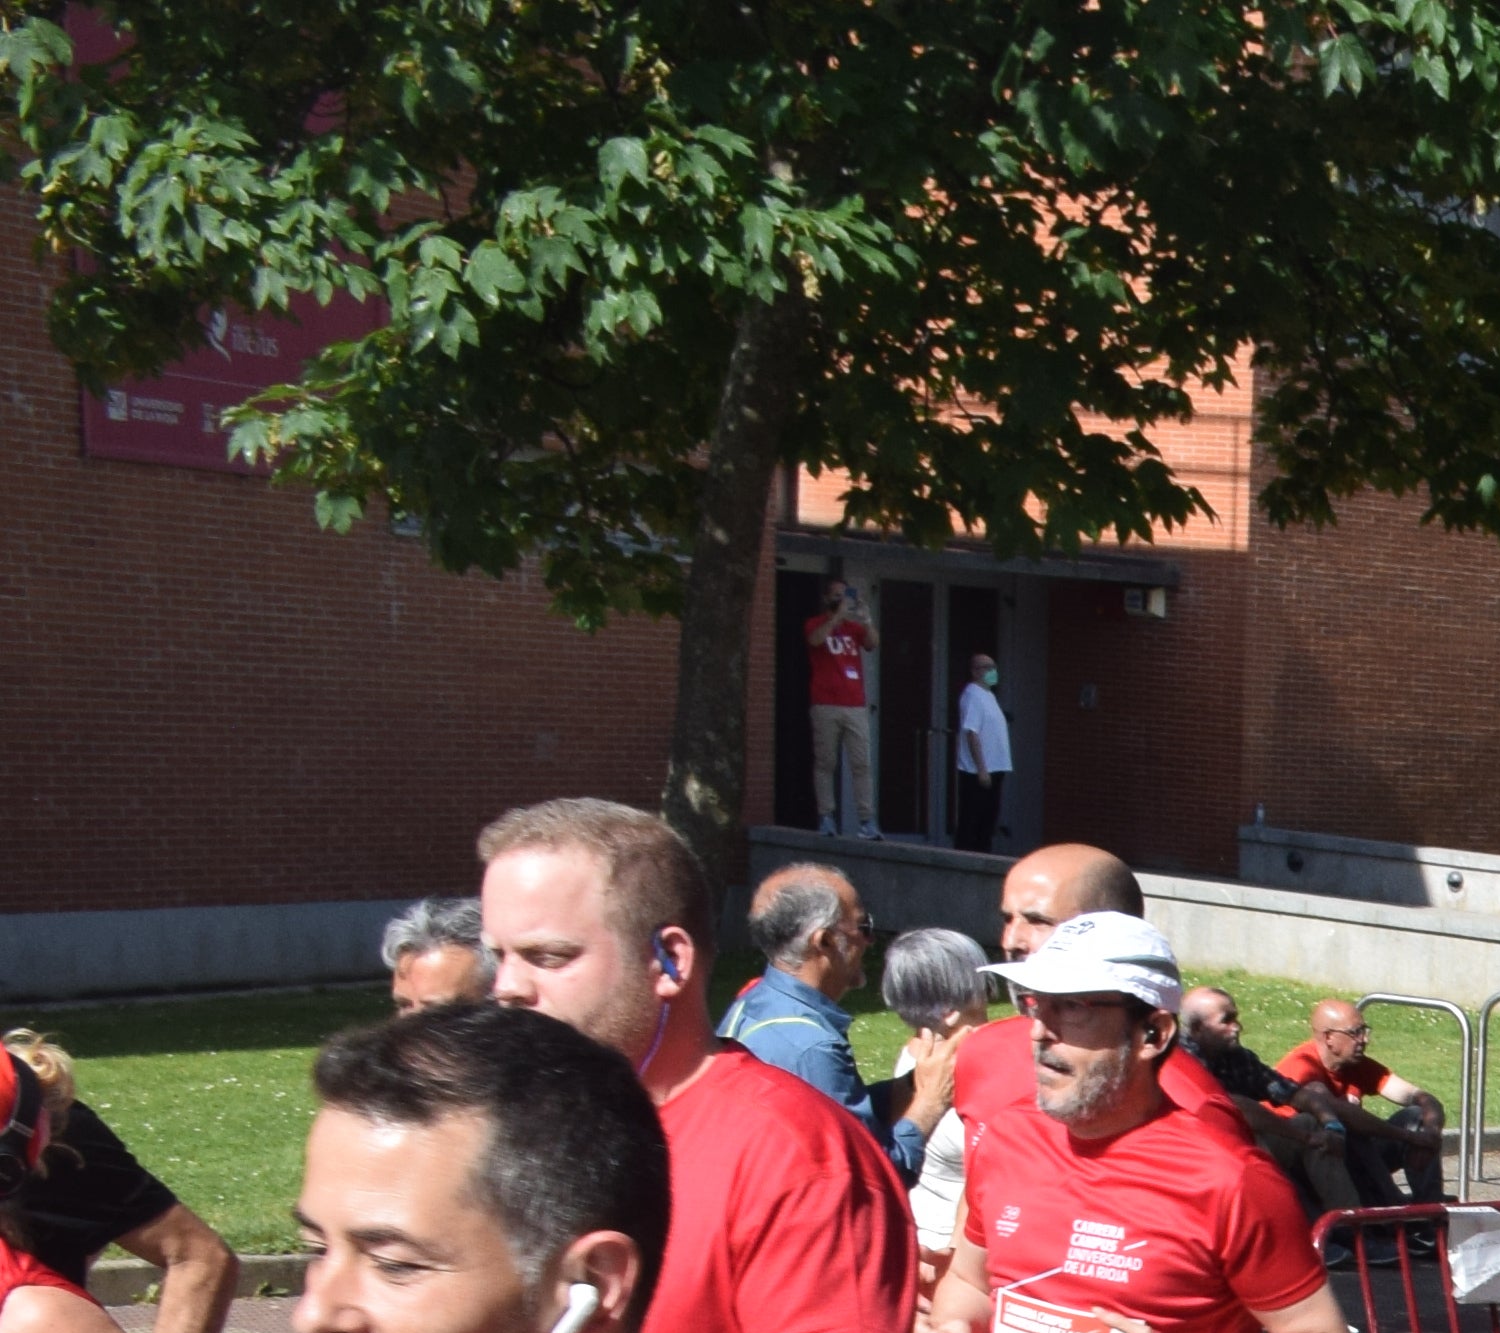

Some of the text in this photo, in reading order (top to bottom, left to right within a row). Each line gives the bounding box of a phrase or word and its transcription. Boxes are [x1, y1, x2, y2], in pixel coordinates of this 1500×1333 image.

[1073, 1219, 1126, 1240] CARRERA
[1070, 1233, 1118, 1253] CAMPUS
[1067, 1246, 1143, 1272] UNIVERSIDAD
[1063, 1260, 1130, 1283] DE LA RIOJA
